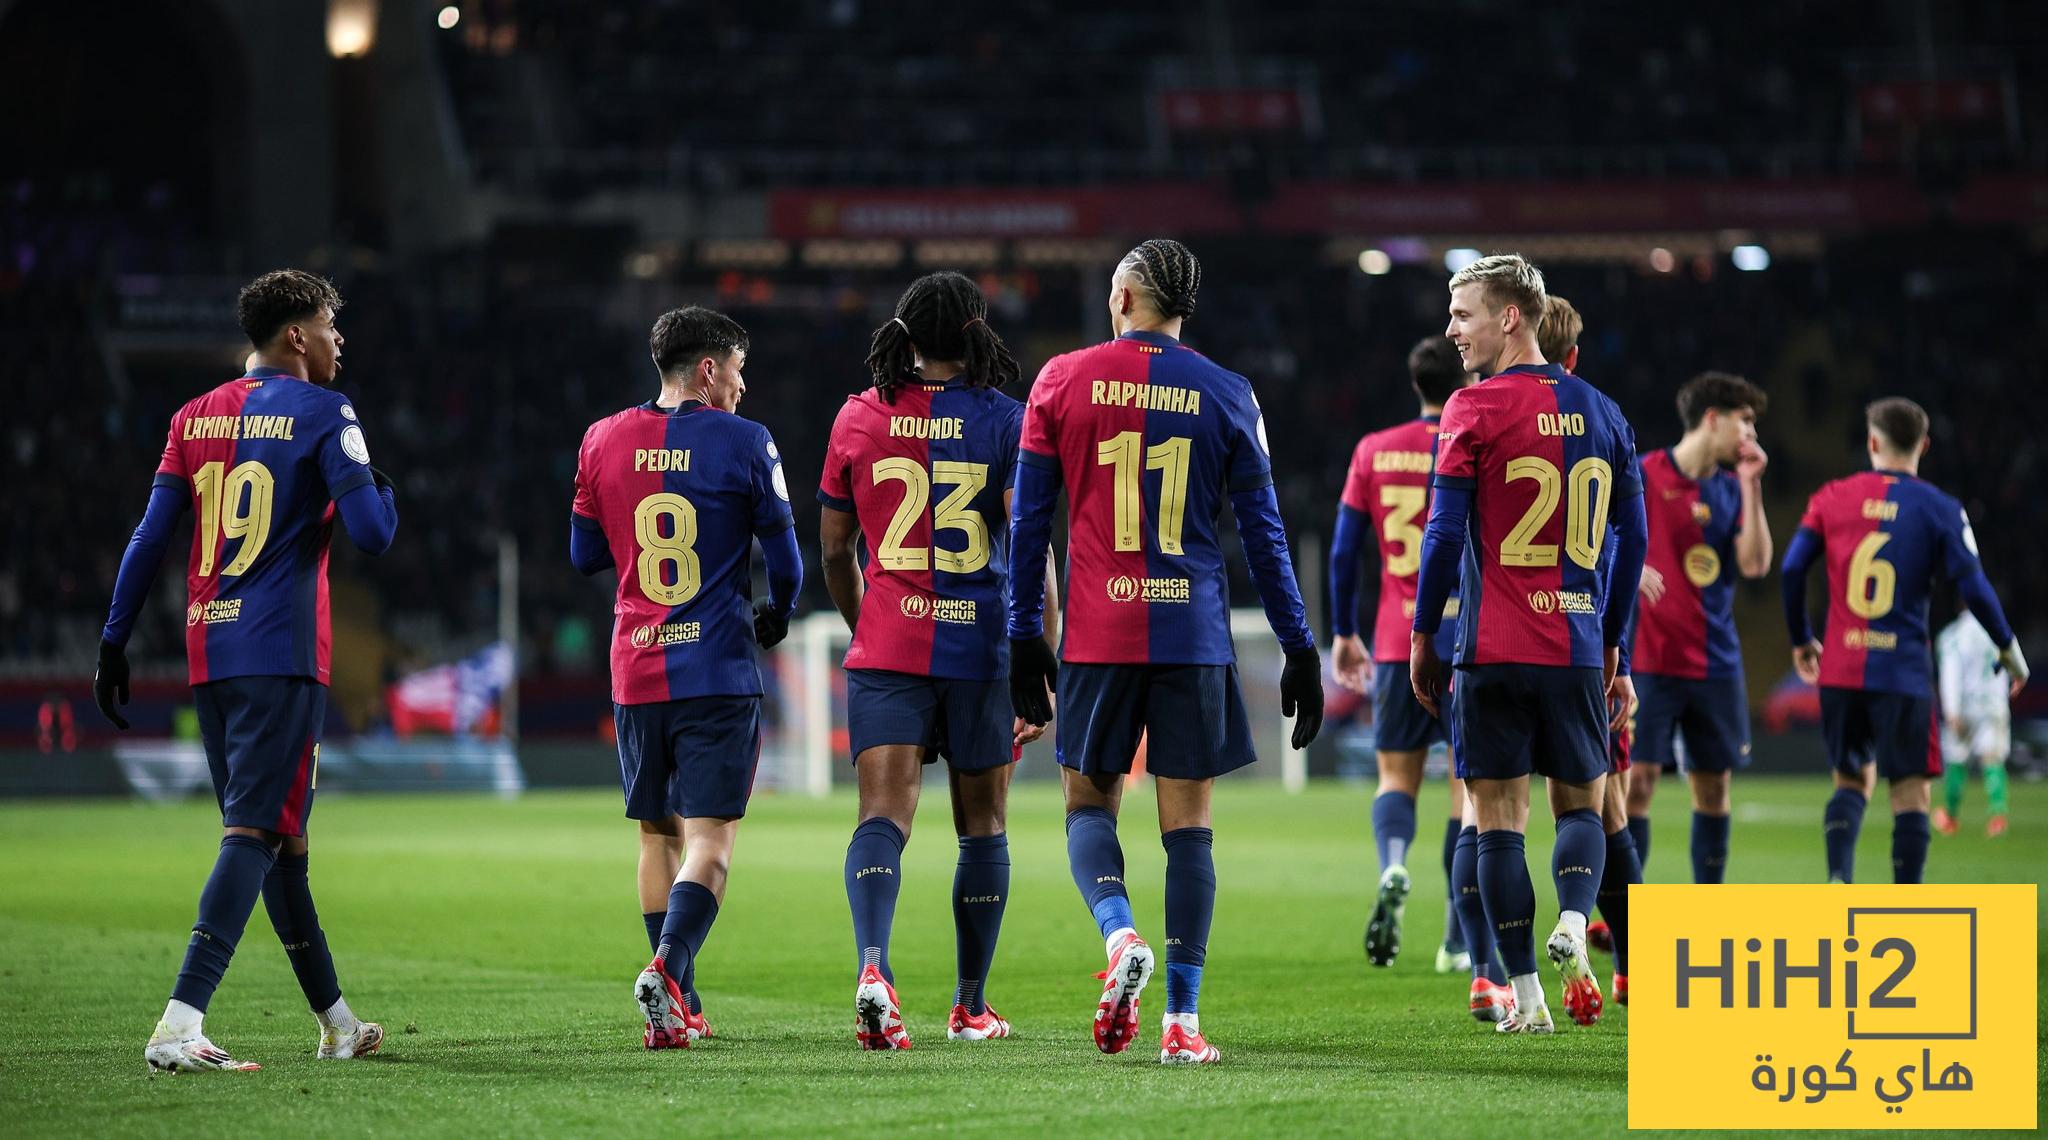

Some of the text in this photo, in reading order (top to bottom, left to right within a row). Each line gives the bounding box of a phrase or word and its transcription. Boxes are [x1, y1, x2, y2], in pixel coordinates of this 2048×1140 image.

[1091, 380, 1201, 415] RAPHINHA
[183, 416, 295, 441] LAMINE YAMAL
[889, 416, 964, 440] KOUNDE
[1536, 413, 1585, 436] OLMO
[634, 449, 691, 472] PEDRI
[1097, 430, 1192, 556] 11
[192, 460, 275, 577] 19
[872, 456, 990, 574] 23
[1500, 456, 1612, 570] 20
[1380, 485, 1426, 577] 3
[634, 492, 701, 606] 8
[1141, 578, 1190, 588] UNHCR
[1846, 530, 1896, 620] 6
[204, 599, 243, 610] UNHCR
[933, 599, 976, 610] UNHCR
[1141, 588, 1190, 599] ACNUR
[1555, 590, 1591, 603] UNHCR
[1558, 600, 1595, 610] ACNUR
[202, 609, 240, 620] ACNUR
[931, 609, 976, 620] ACNUR
[656, 631, 700, 644] ACNUR
[657, 622, 701, 633] UNHCR
